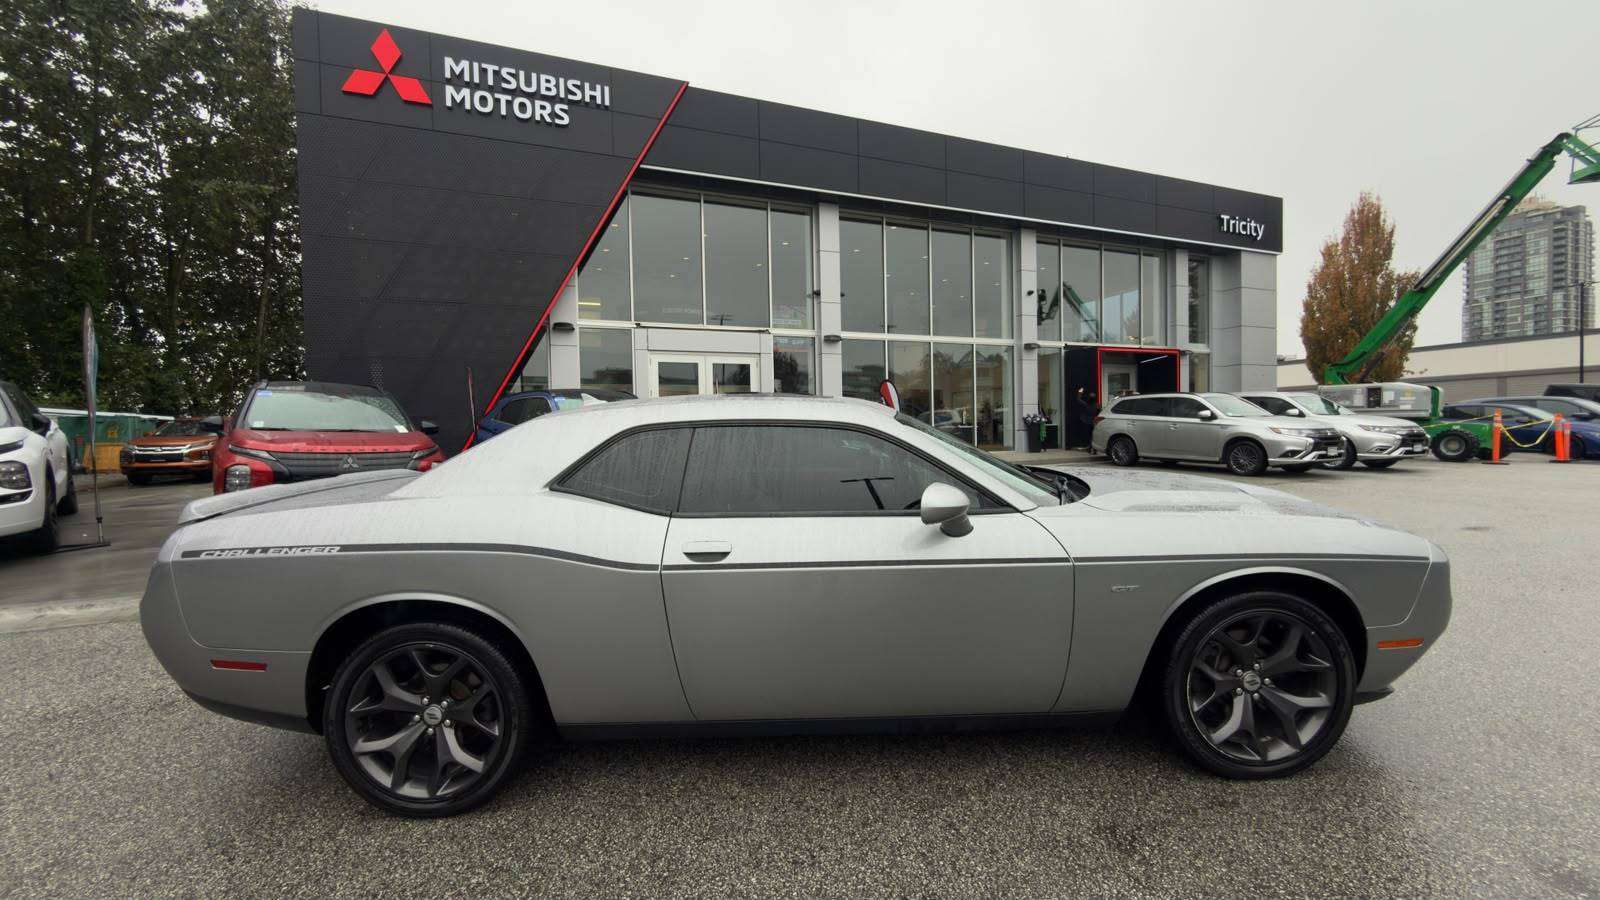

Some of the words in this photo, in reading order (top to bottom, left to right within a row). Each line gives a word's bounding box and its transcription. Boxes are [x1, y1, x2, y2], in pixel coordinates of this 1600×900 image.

[444, 56, 610, 106] MITSUBISHI
[445, 85, 570, 126] MOTORS
[1220, 214, 1265, 241] Tricity
[199, 545, 341, 559] CHALLENGER
